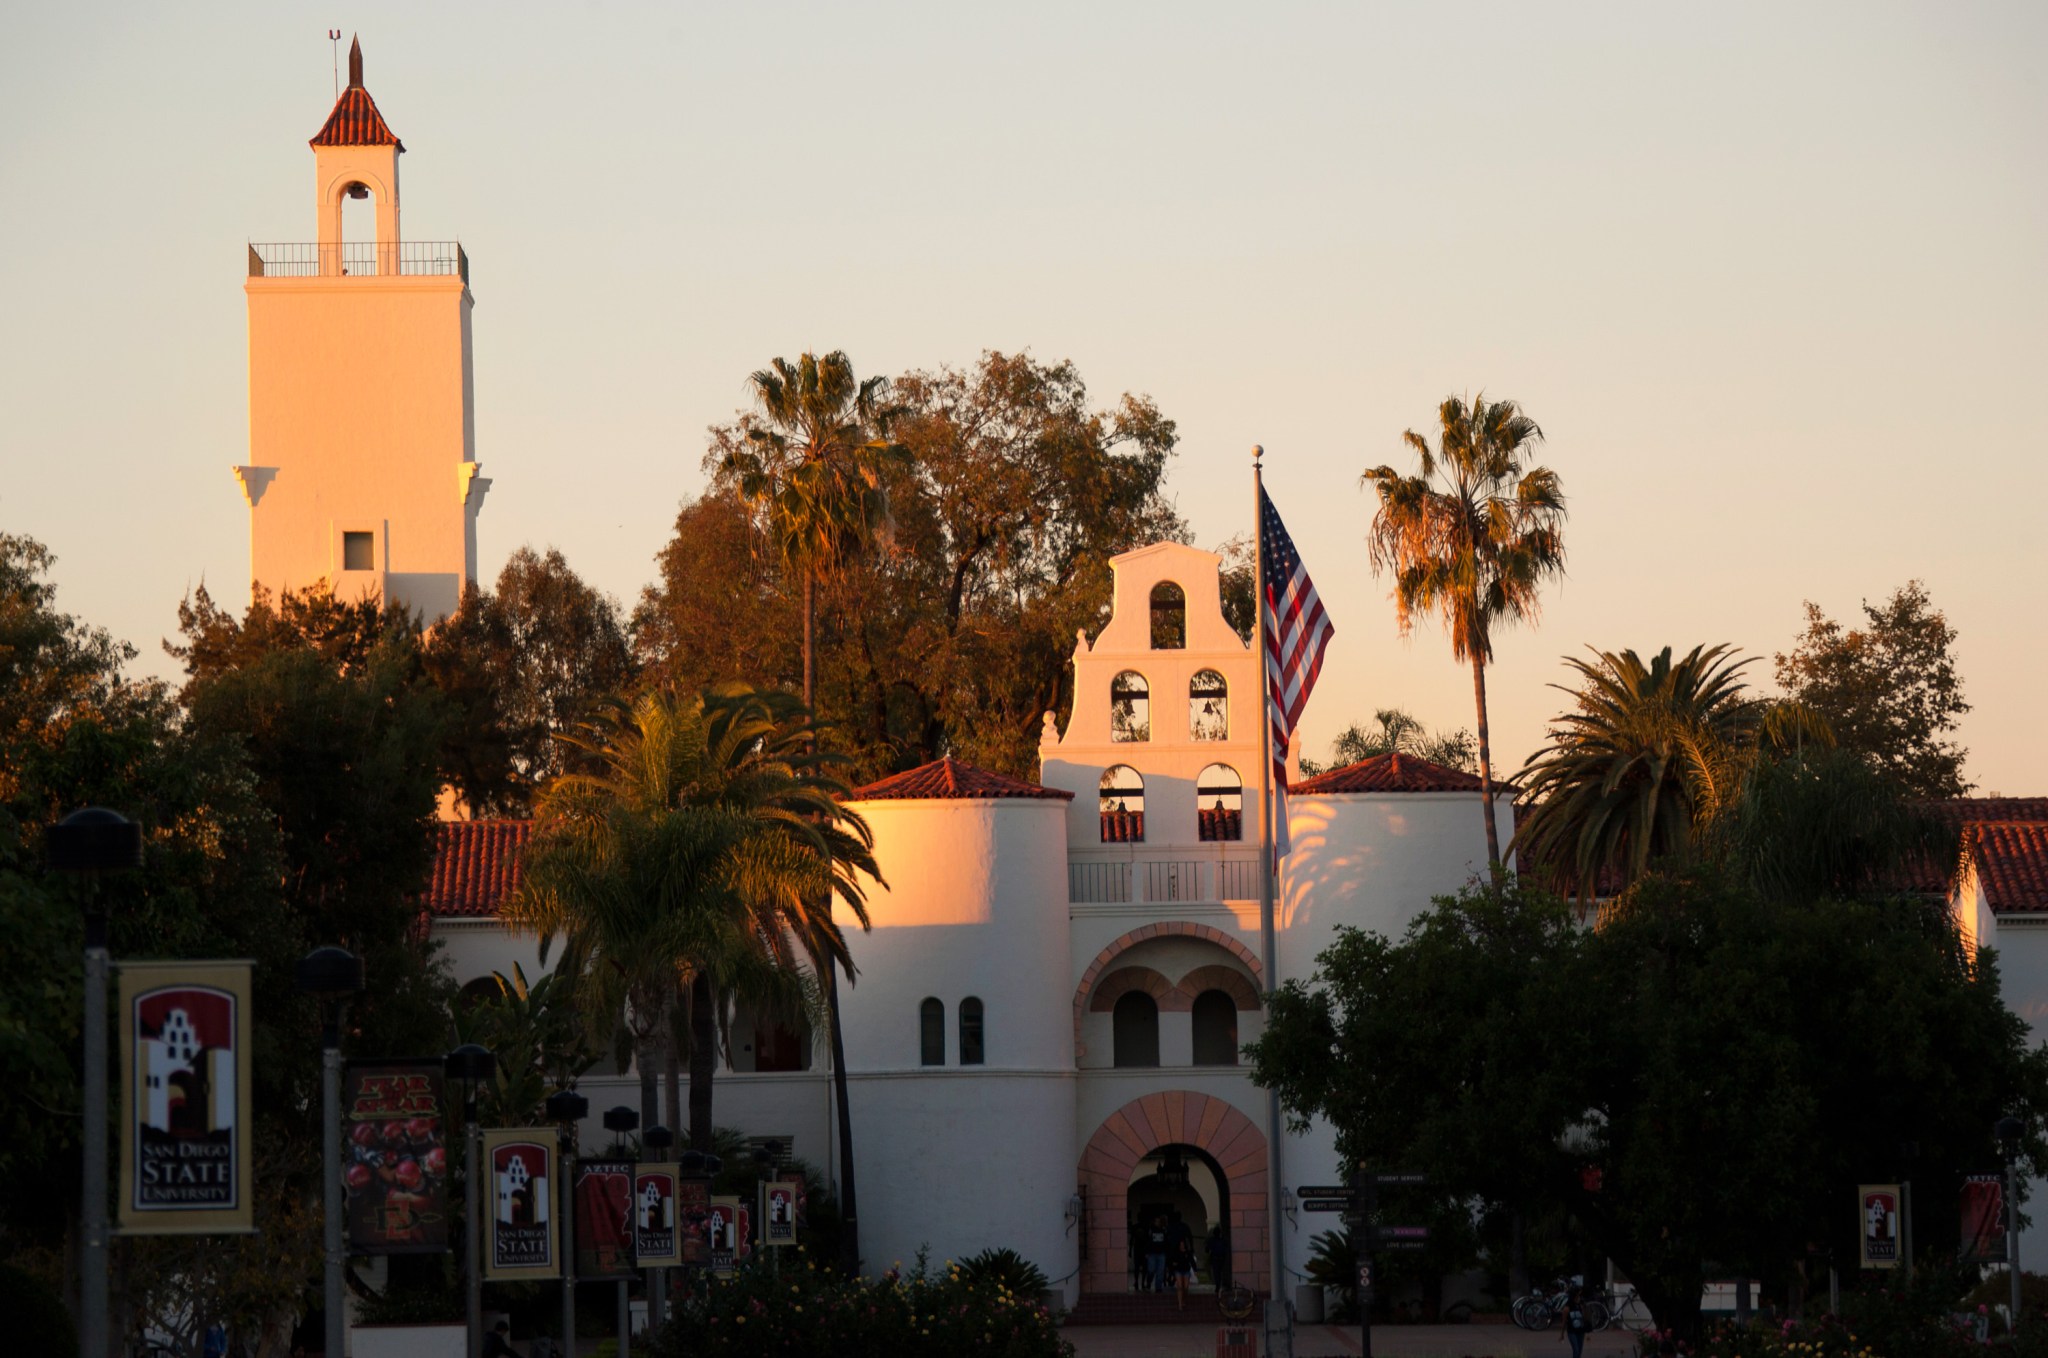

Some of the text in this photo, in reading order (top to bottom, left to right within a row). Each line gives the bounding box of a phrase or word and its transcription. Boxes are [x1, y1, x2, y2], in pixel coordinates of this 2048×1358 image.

[358, 1075, 431, 1093] FEAR
[354, 1096, 437, 1113] SPEAR
[143, 1142, 229, 1157] SAN DIEGO
[143, 1160, 229, 1184] STATE
[584, 1165, 629, 1173] AZTEC
[143, 1186, 228, 1200] UNIVERSITY
[498, 1229, 546, 1239] SAN DIEGO
[498, 1240, 545, 1253] STATE
[640, 1240, 672, 1249] STATE
